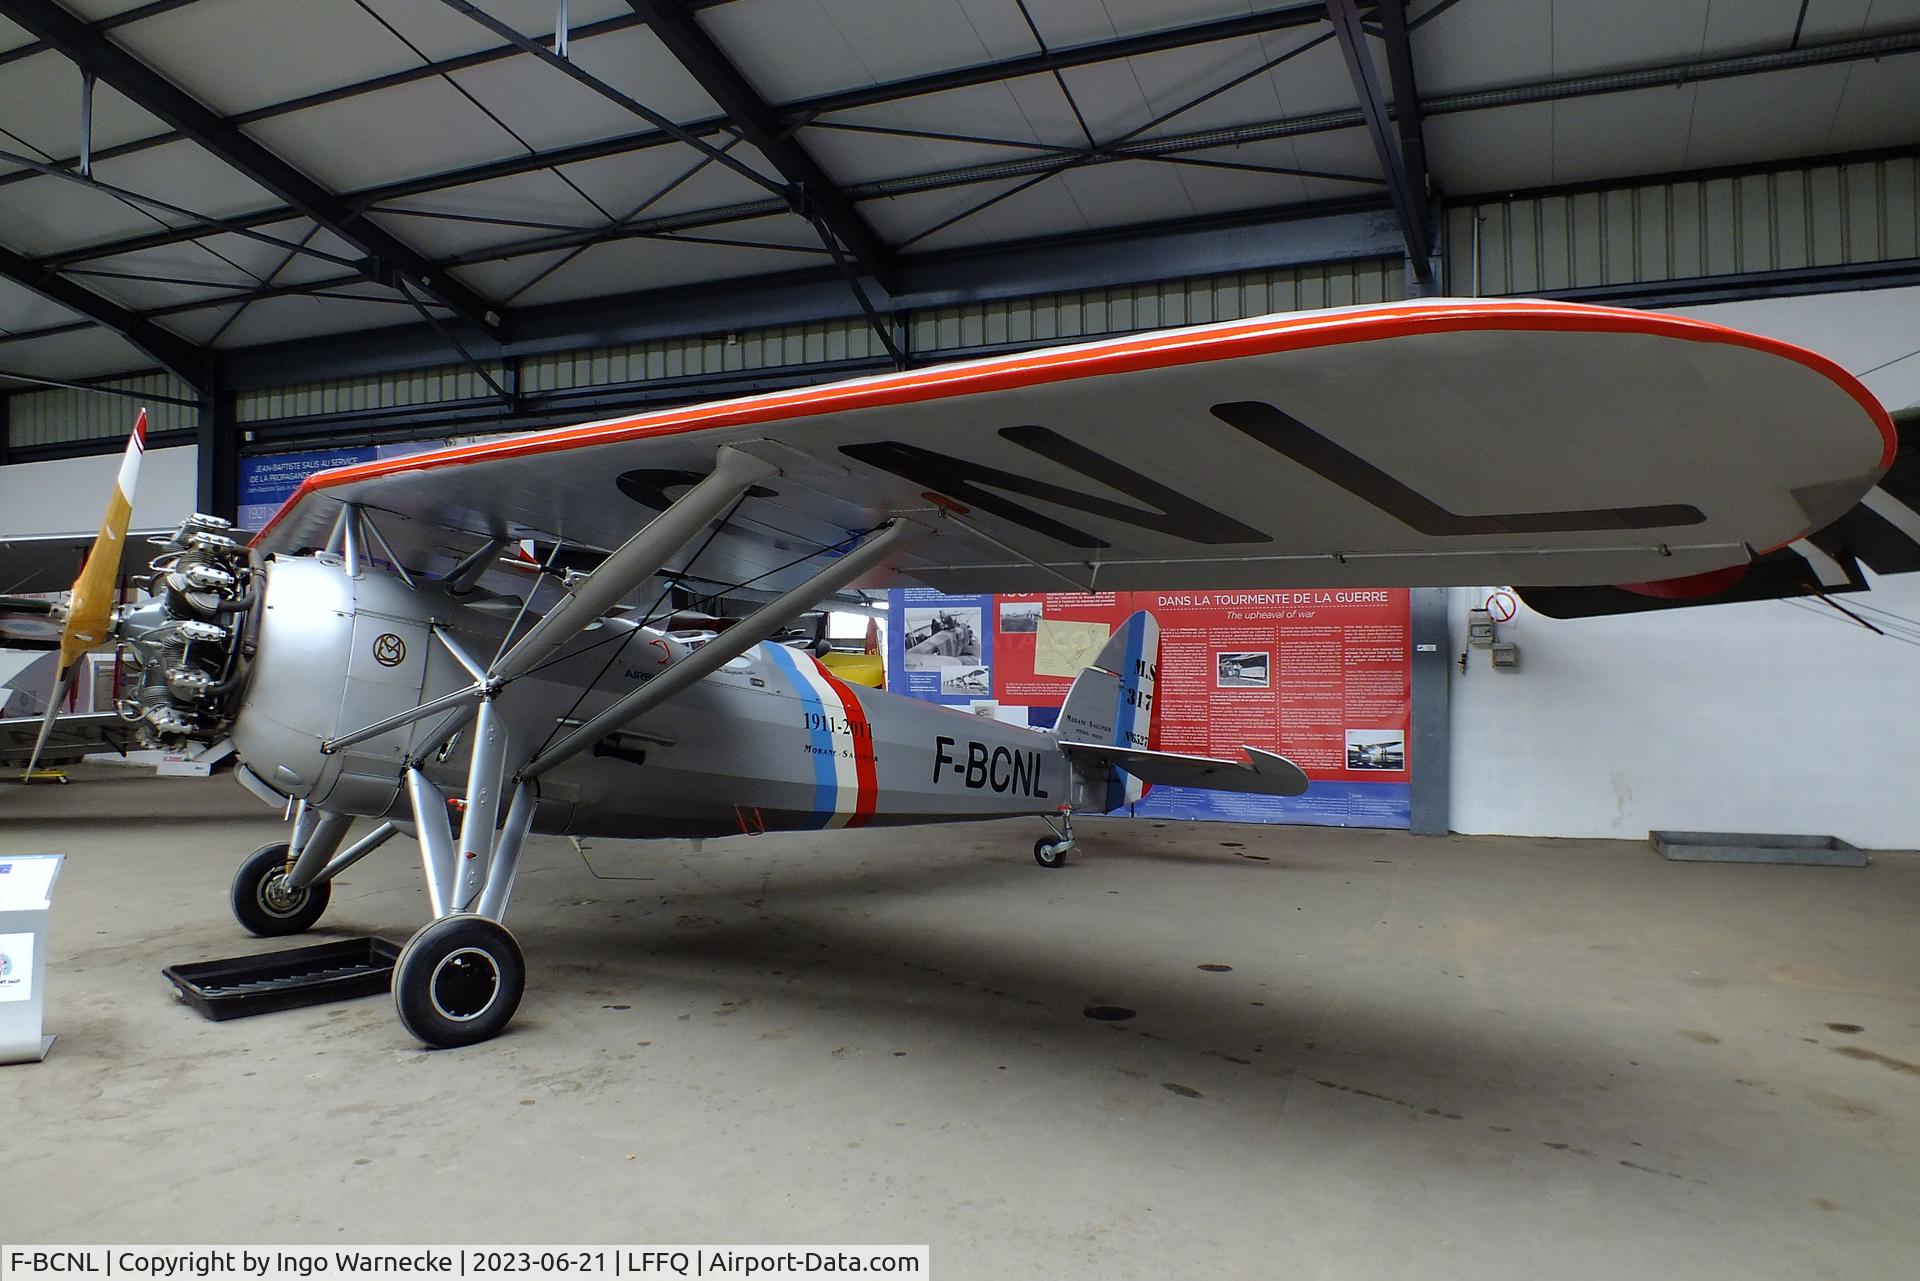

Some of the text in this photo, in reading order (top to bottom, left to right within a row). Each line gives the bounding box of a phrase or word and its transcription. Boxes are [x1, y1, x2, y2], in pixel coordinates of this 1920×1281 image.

[255, 462, 300, 473] JEAN-BAPTISTE
[302, 460, 320, 469] SALIS
[331, 457, 359, 466] SERVICE
[250, 475, 260, 483] DE
[260, 474, 269, 482] LA
[1158, 591, 1388, 606] DANS LA TOURMENTE DE LA GUERRE
[1227, 610, 1316, 621] The upheaval of war
[1127, 688, 1152, 712] 317
[803, 712, 873, 740] 1911-2011
[933, 735, 1048, 798] F-BCNL
